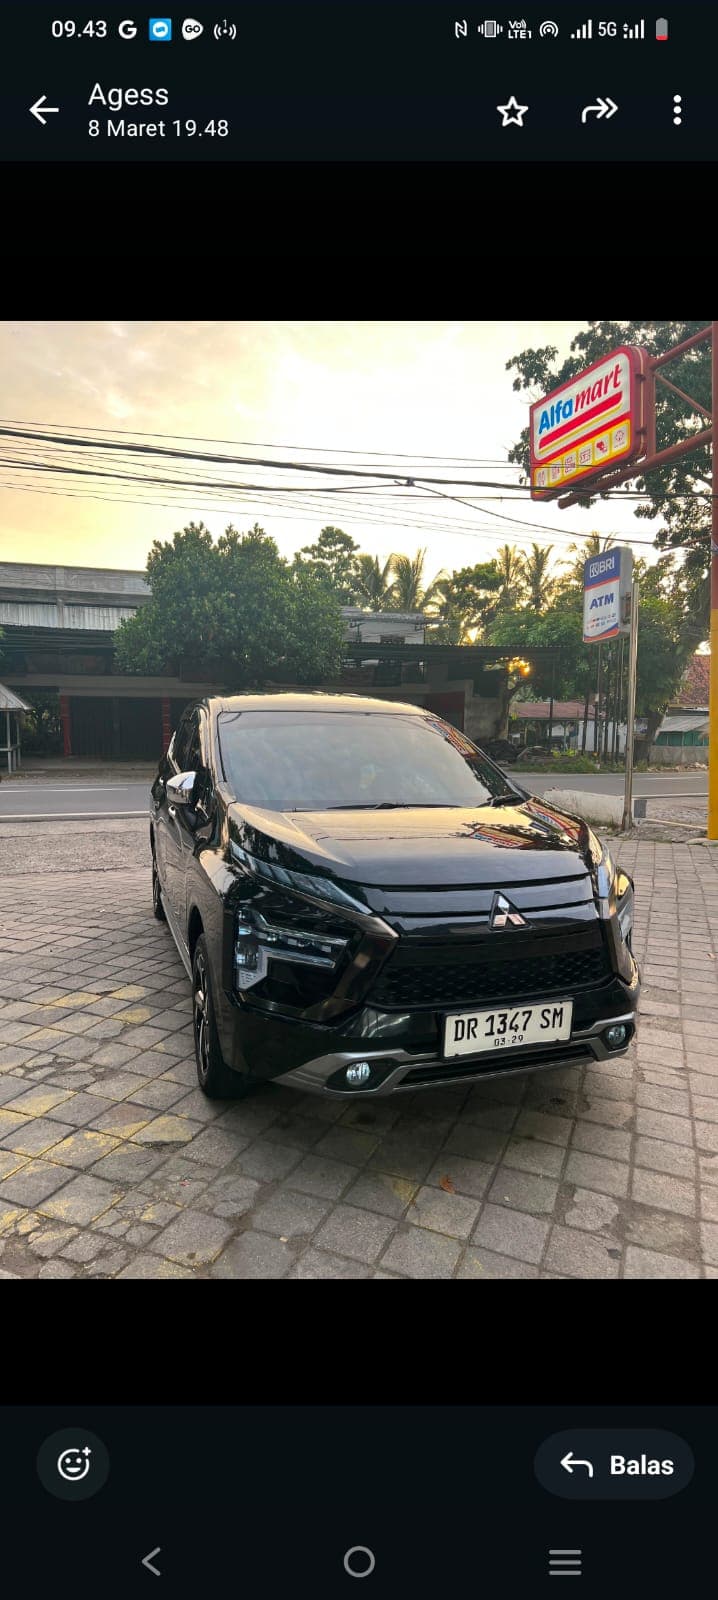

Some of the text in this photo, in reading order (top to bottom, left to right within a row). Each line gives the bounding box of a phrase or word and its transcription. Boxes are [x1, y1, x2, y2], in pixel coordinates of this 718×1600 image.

[538, 363, 623, 435] Alfamart
[599, 556, 615, 573] BRI
[589, 592, 615, 610] ATM
[454, 1007, 563, 1041] DR 1347 SM
